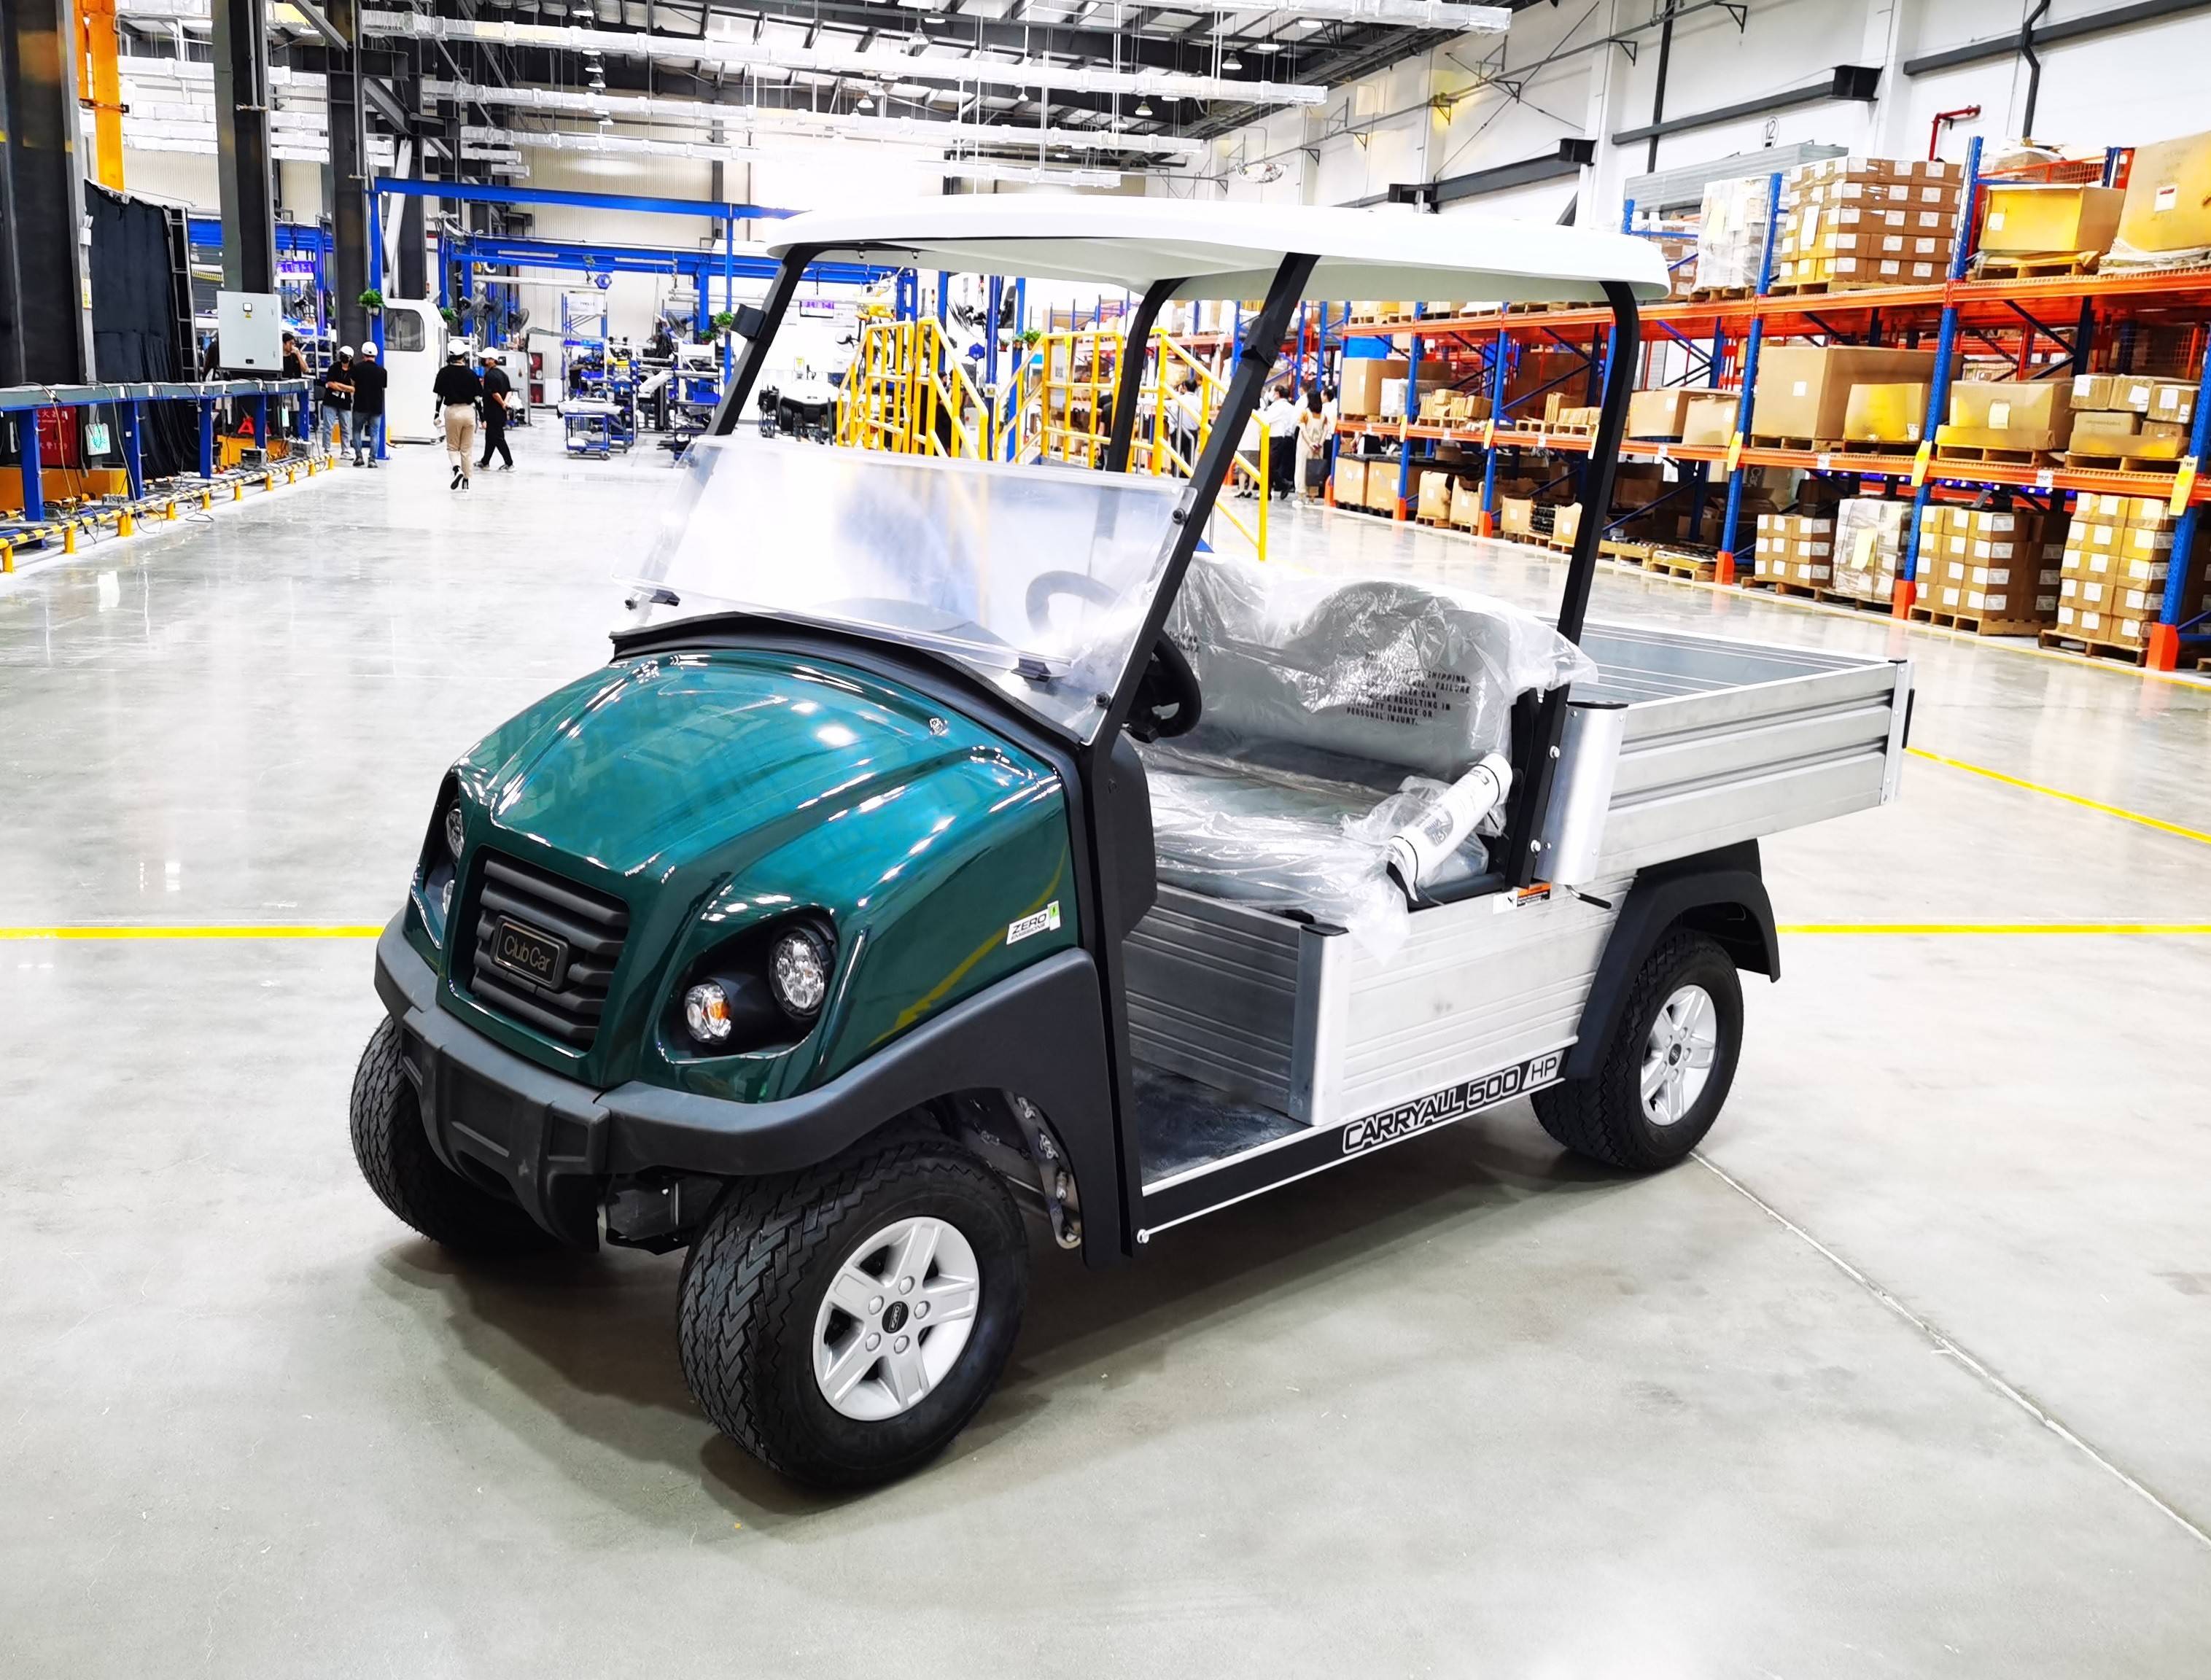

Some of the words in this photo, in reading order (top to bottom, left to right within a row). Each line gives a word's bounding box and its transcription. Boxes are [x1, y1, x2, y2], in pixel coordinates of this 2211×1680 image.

[1765, 120, 1776, 140] 12
[1427, 670, 1466, 683] SHIPPING
[1421, 690, 1437, 699] CAN
[1435, 682, 1470, 693] FAILURE
[1388, 704, 1418, 716] DAMAGE
[1422, 709, 1433, 718] OR
[1394, 694, 1438, 709] RESULTING
[1441, 702, 1450, 711] IN
[1346, 706, 1383, 720] PERSONAL
[1387, 714, 1418, 726] INJURY.
[1012, 913, 1047, 935] ZERO
[504, 935, 529, 963] Club
[529, 946, 551, 973] Car
[1343, 1088, 1464, 1154] CARRYALL
[1466, 1065, 1520, 1108] 500
[1531, 1056, 1557, 1082] HP
